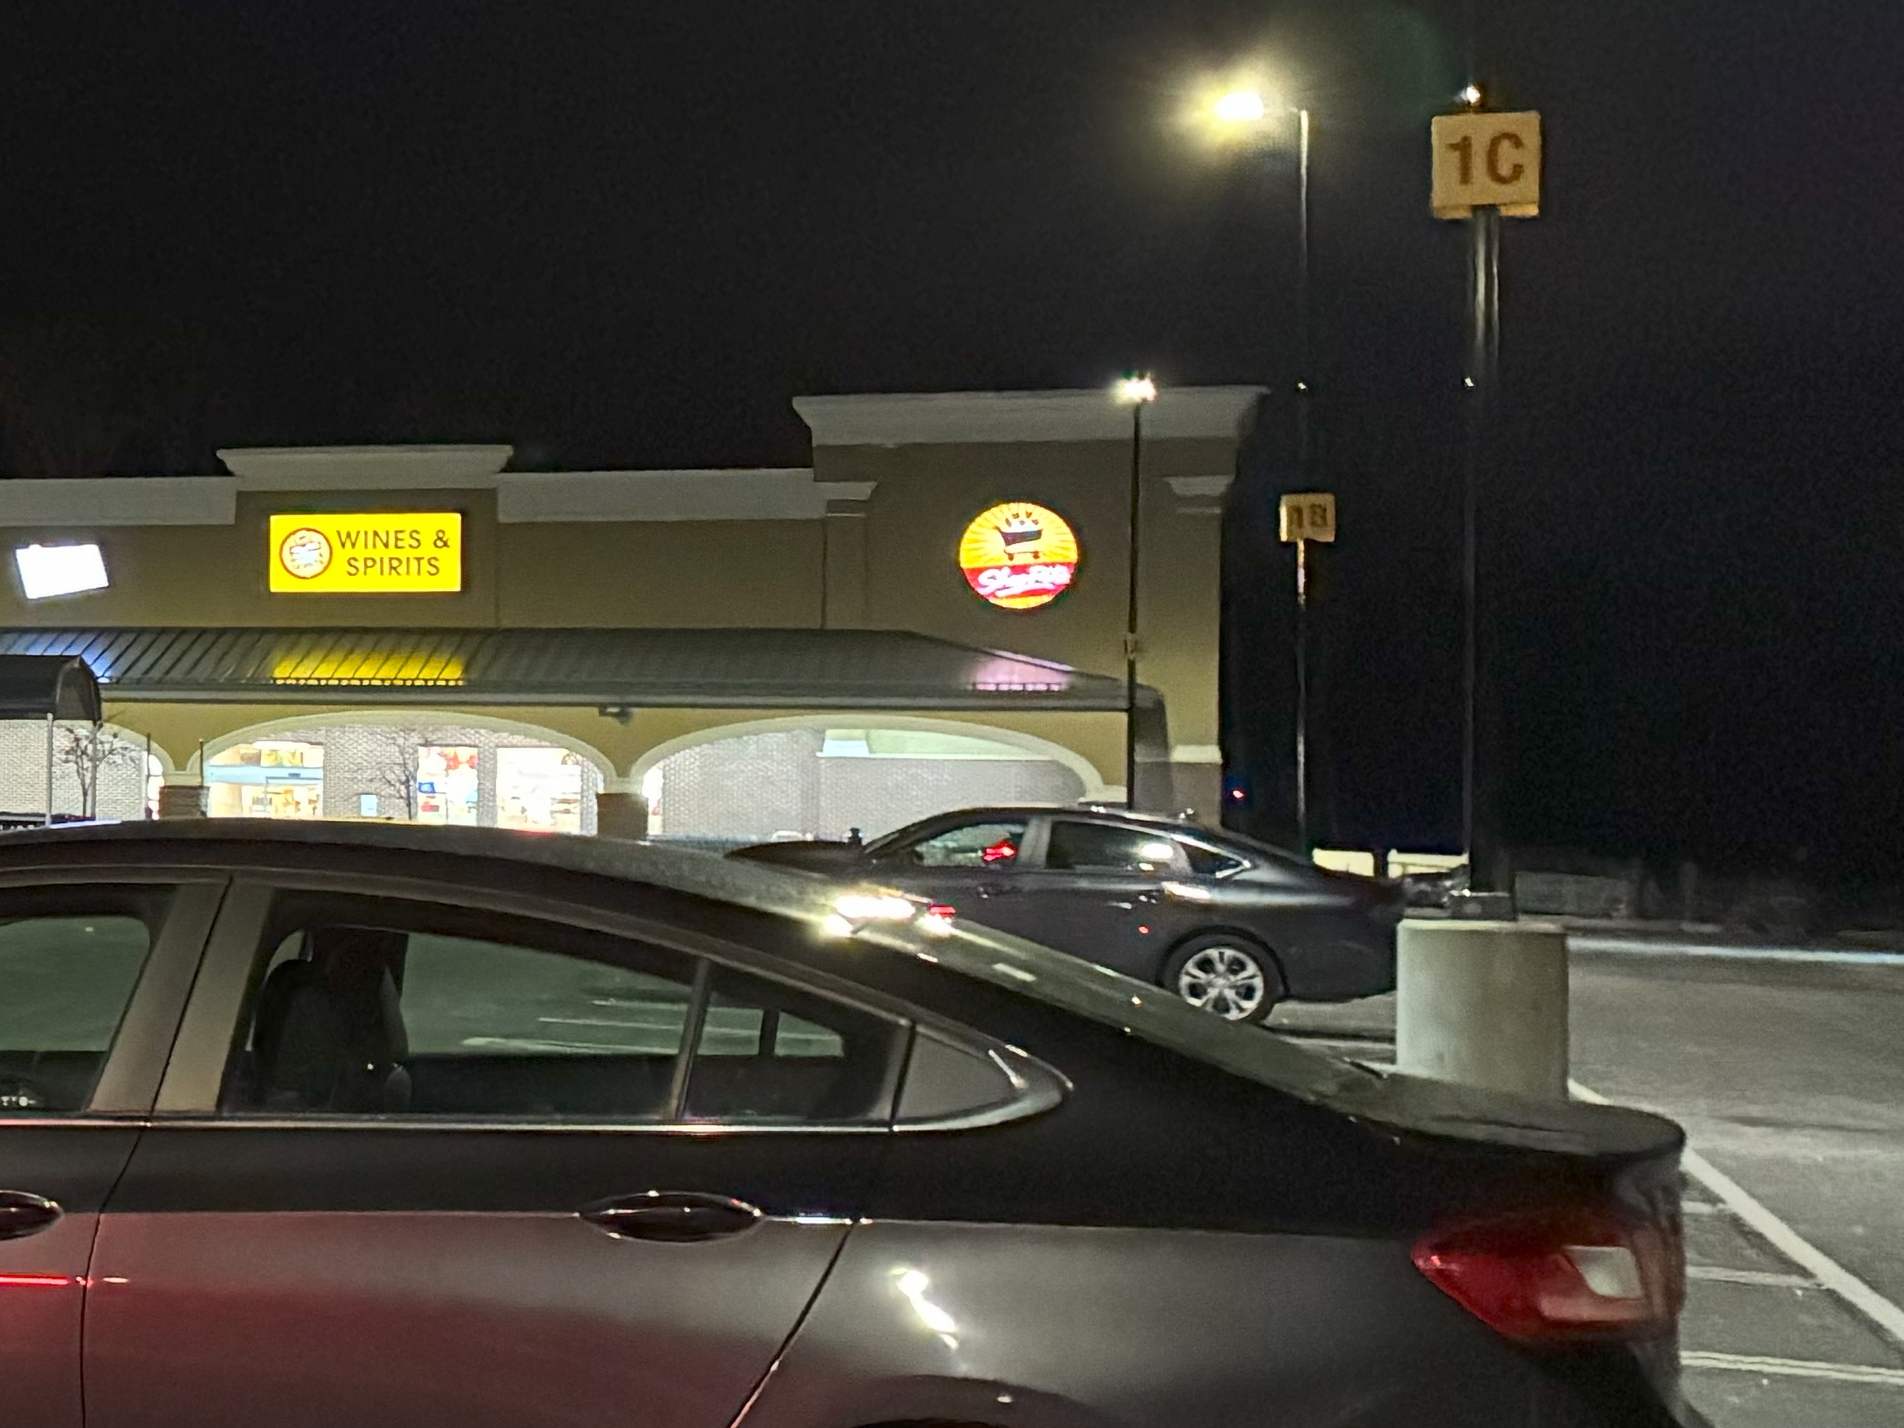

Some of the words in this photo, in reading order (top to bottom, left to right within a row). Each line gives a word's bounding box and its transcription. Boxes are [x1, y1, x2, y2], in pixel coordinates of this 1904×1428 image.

[1445, 132, 1524, 185] 1C
[336, 529, 422, 550] WINES
[432, 529, 451, 550] &
[345, 556, 441, 577] SPIRITS
